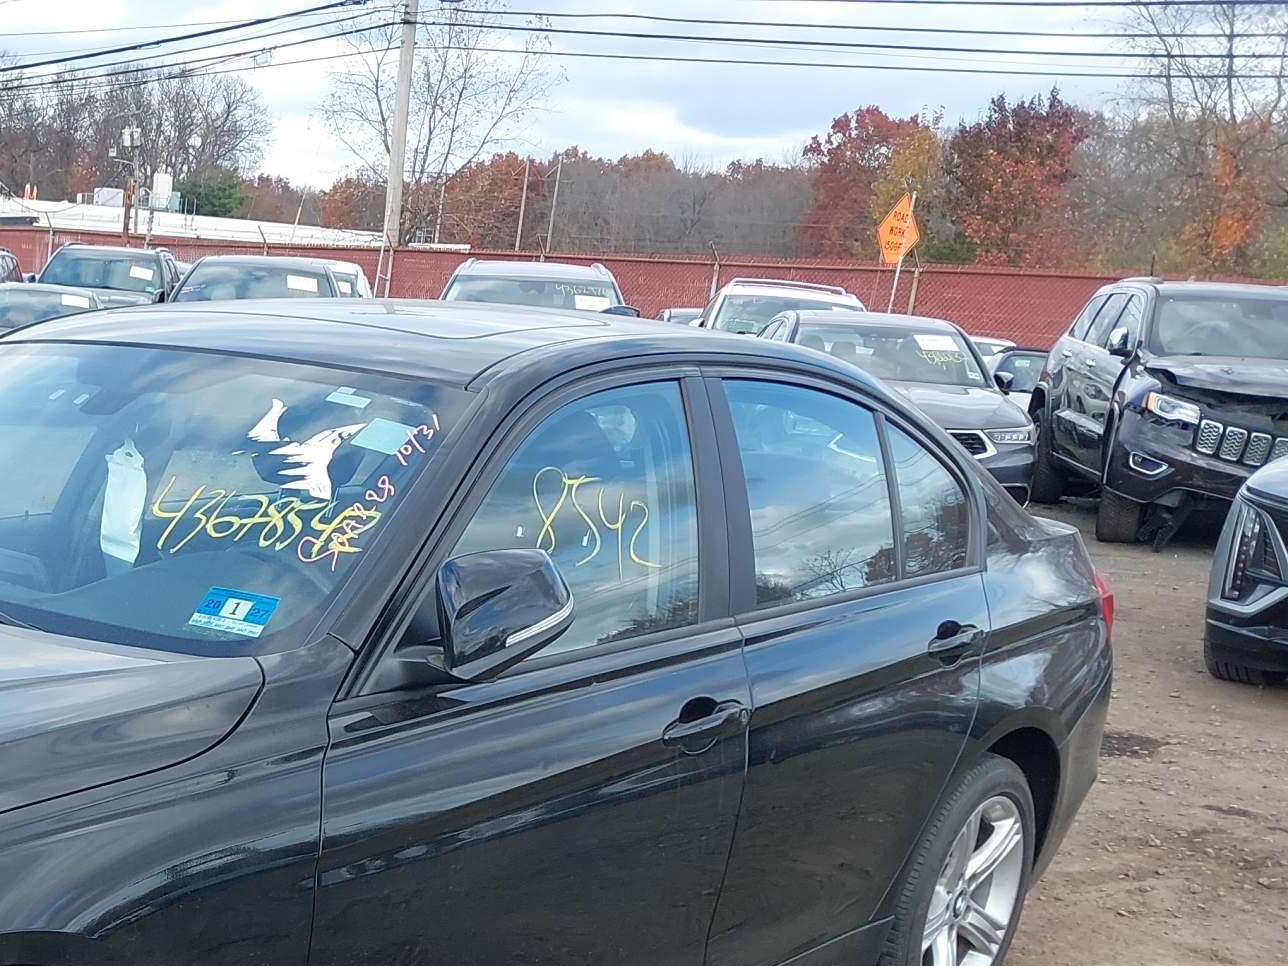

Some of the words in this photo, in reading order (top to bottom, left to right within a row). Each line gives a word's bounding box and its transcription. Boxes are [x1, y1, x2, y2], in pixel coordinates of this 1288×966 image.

[893, 210, 909, 223] ROAD
[889, 225, 905, 238] WORK
[395, 413, 441, 467] 10/31
[532, 464, 663, 584] 8542
[205, 599, 221, 609] 20
[229, 602, 241, 615] 1
[250, 608, 269, 618] 27
